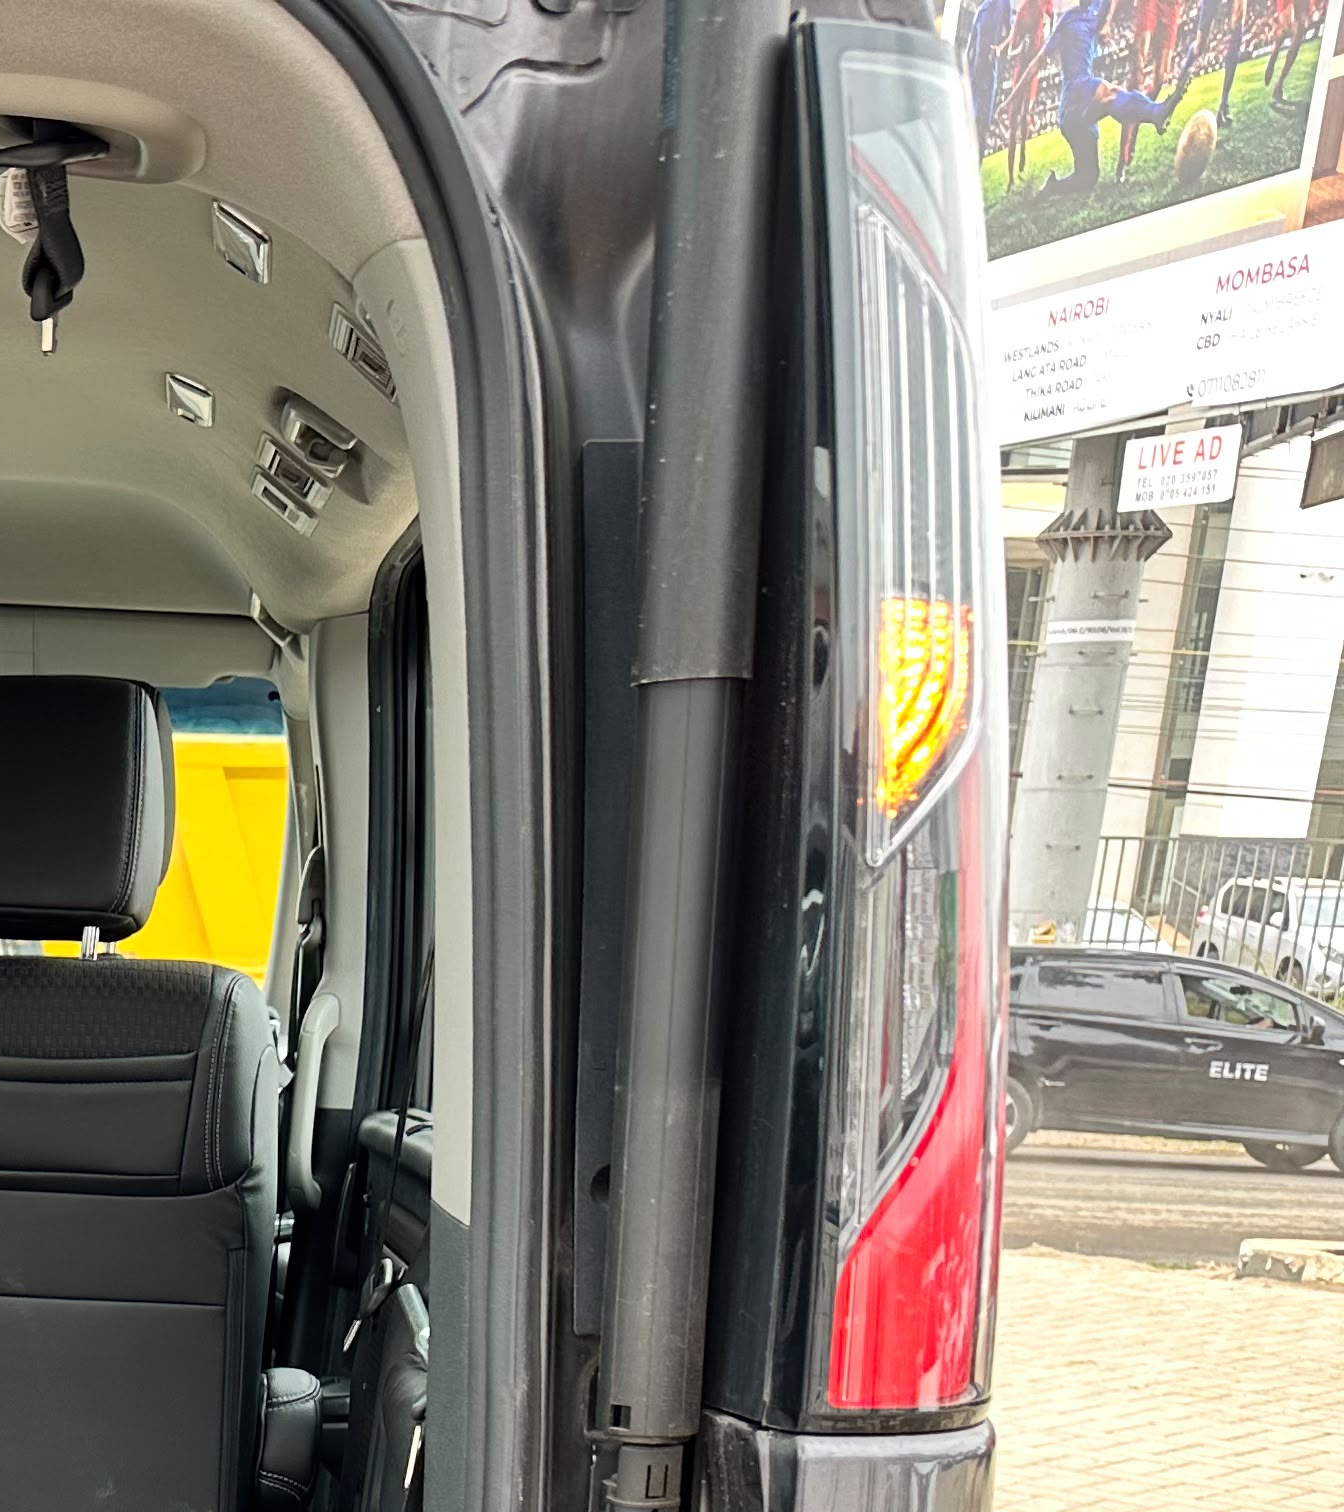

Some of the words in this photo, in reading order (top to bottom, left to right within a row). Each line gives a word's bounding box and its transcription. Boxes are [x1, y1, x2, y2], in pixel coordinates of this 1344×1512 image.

[1216, 253, 1310, 295] MOMBASA
[1048, 296, 1110, 328] NAIROBI
[1200, 306, 1232, 326] NYALI
[1004, 340, 1060, 363] WESTLANDS
[1196, 333, 1220, 350] CBD
[1059, 354, 1086, 371] ROAD
[1026, 384, 1052, 400] THIKA
[1054, 377, 1082, 393] ROAD
[1138, 440, 1185, 470] LIVE
[1194, 435, 1222, 462] AD
[1137, 477, 1152, 488] TEL
[1136, 490, 1154, 502] MOB
[1208, 1060, 1270, 1082] ELITE
